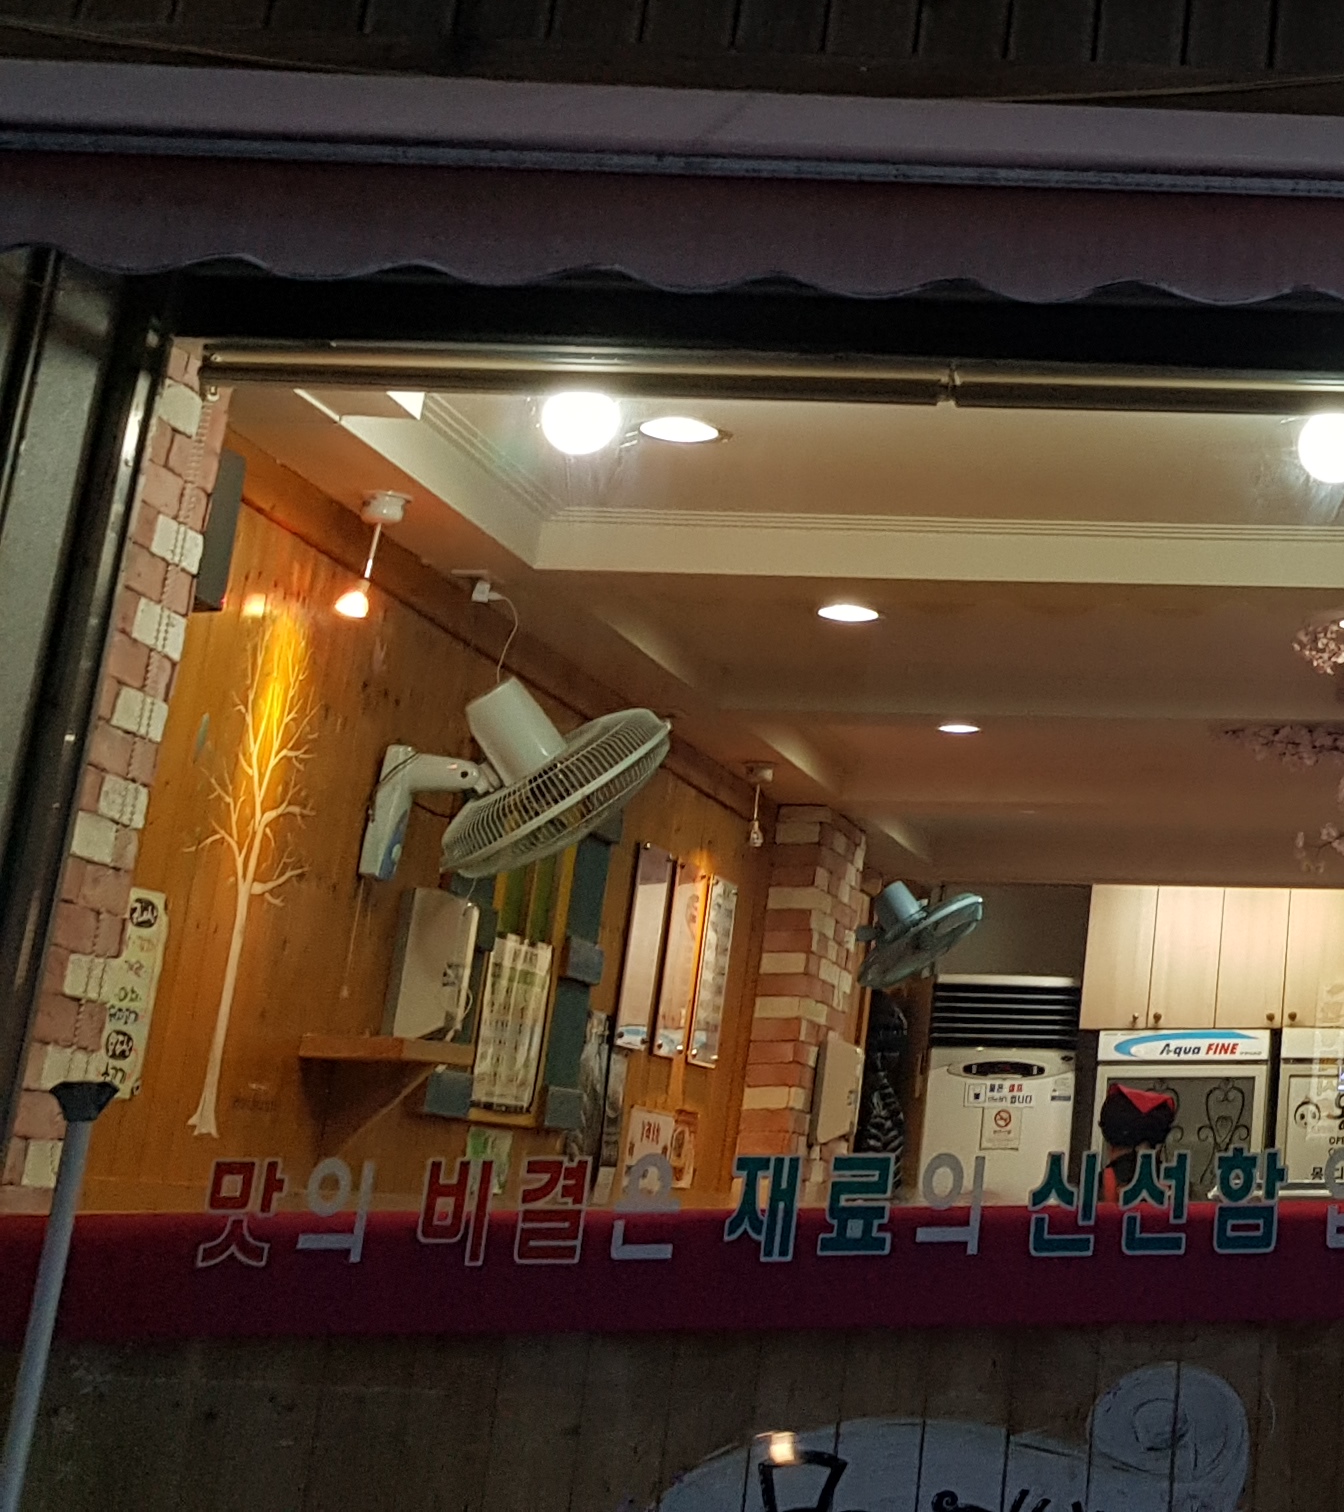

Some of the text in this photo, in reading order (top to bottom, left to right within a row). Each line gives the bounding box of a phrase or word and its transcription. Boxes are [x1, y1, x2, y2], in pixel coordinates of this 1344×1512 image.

[1159, 1043, 1240, 1057] Aqua FINE
[196, 1153, 376, 1268] 맛의
[416, 1152, 681, 1266] 비결은
[723, 1151, 985, 1262] 재료의
[1028, 1145, 1287, 1257] 신선함
